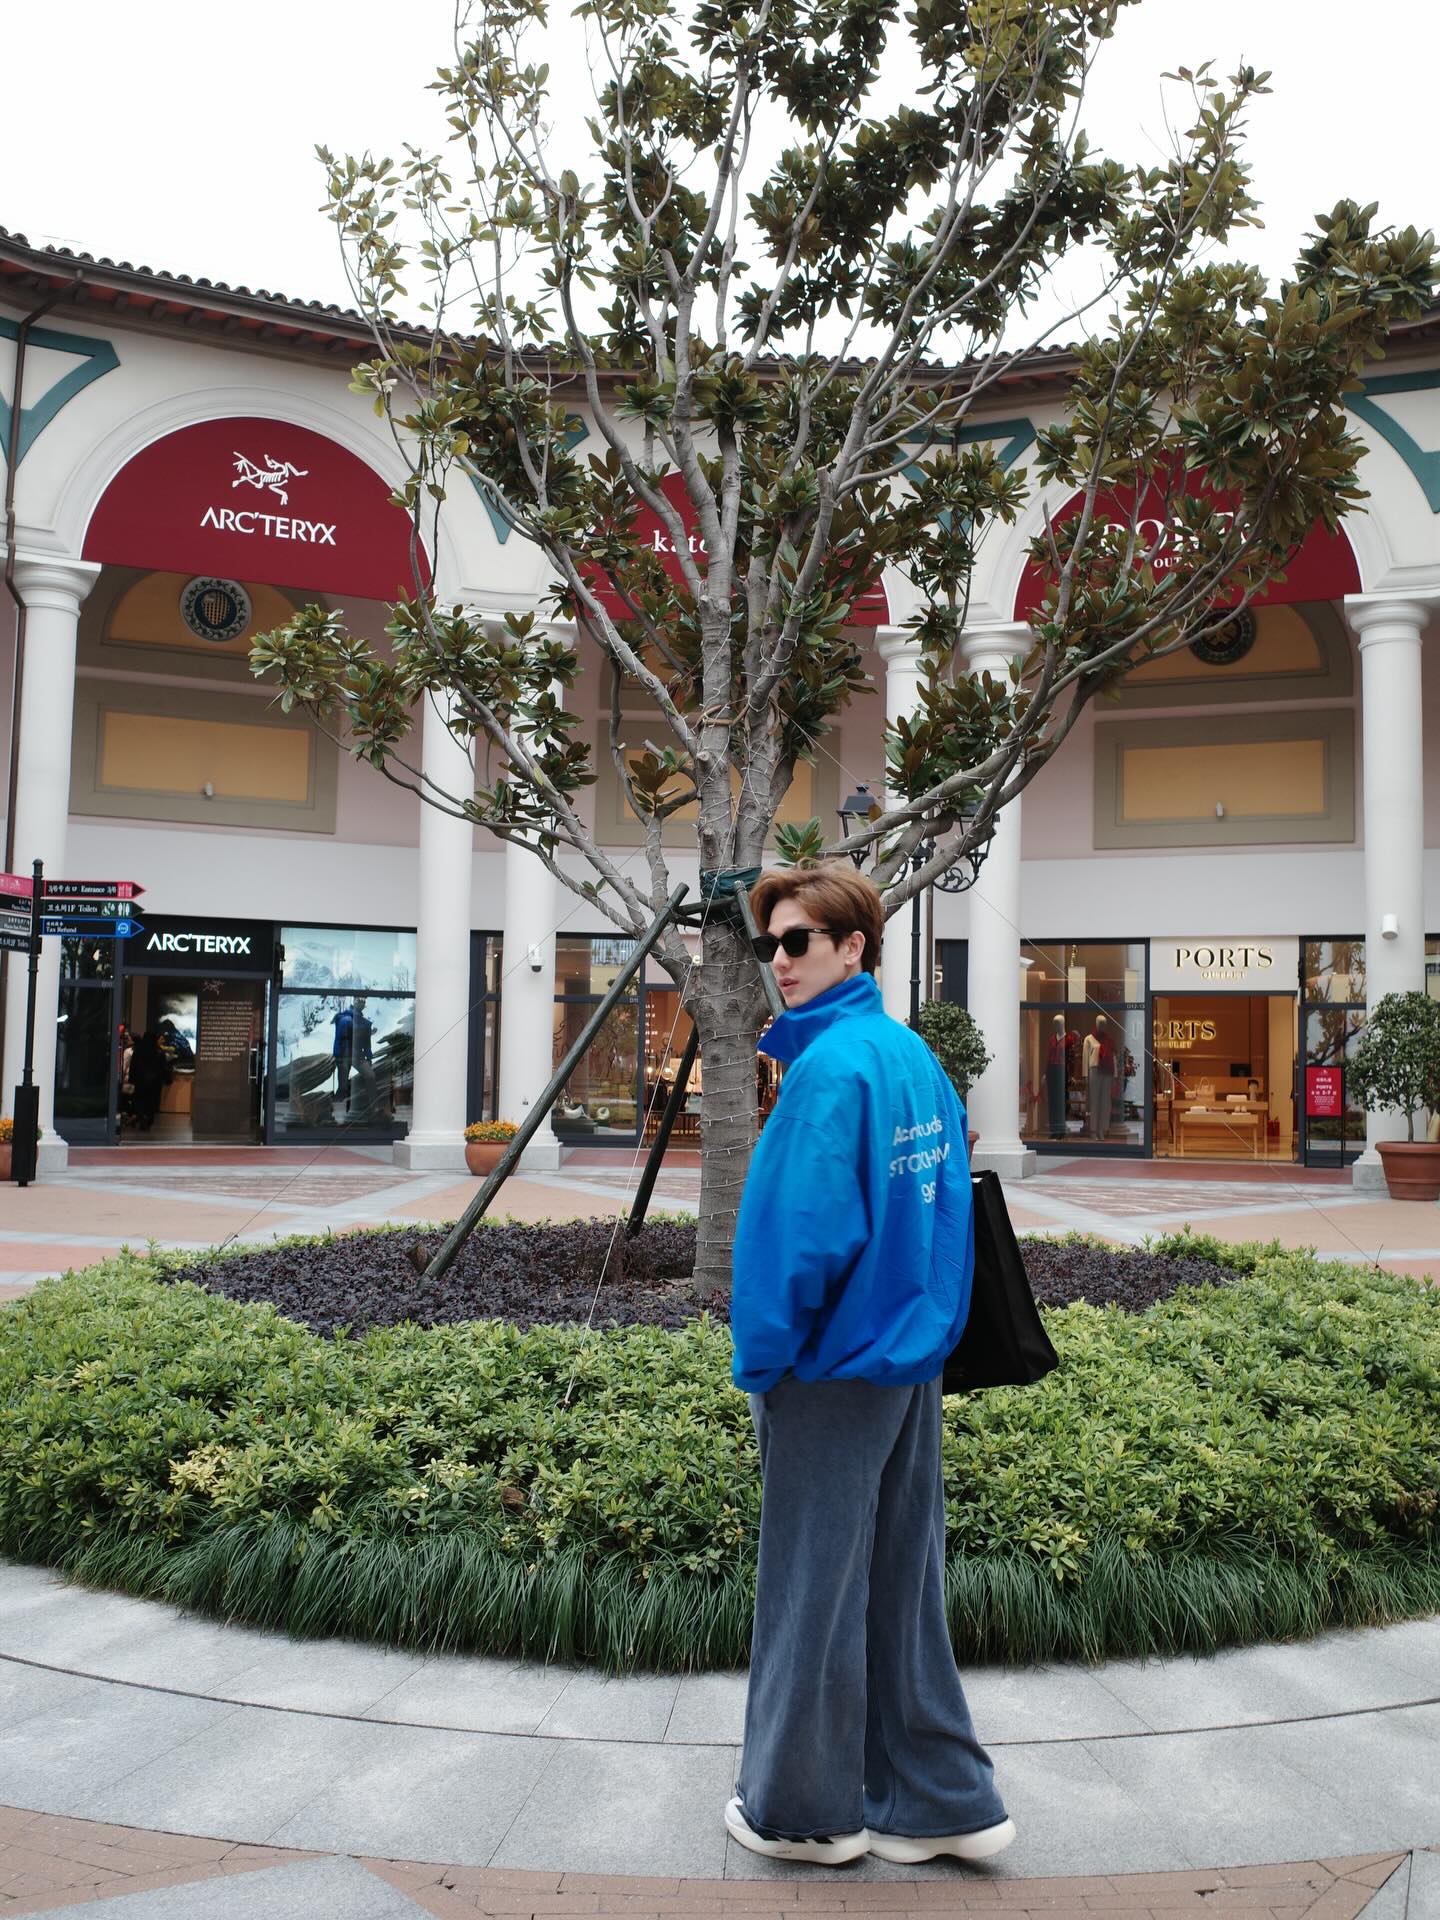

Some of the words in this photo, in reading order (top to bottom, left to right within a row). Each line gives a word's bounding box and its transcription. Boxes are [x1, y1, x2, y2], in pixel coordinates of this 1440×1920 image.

[200, 506, 337, 546] ARC'TERYX
[81, 885, 105, 893] Entrance
[78, 904, 98, 913] Toilets
[146, 933, 251, 954] ARC'TERYX
[1176, 947, 1273, 969] PORTS
[1153, 1020, 1217, 1041] ORTS
